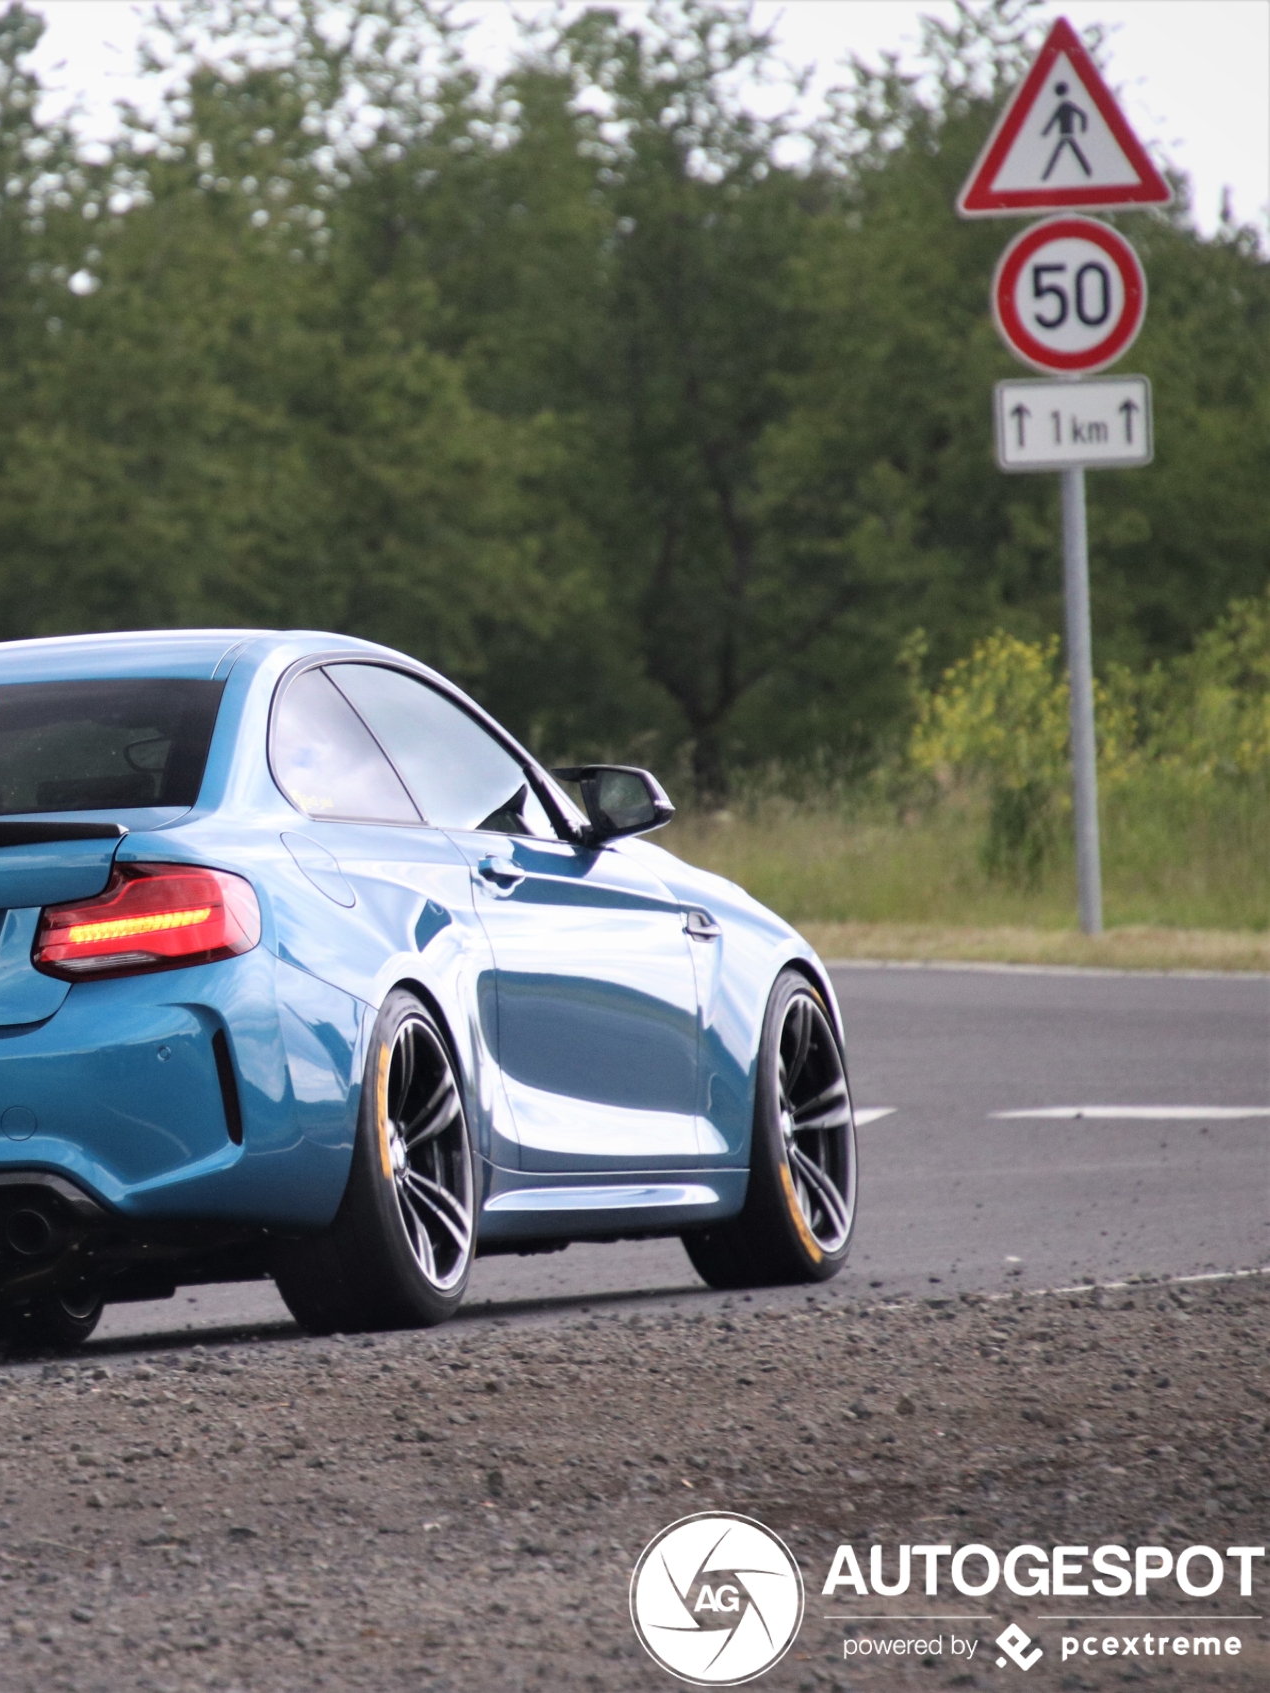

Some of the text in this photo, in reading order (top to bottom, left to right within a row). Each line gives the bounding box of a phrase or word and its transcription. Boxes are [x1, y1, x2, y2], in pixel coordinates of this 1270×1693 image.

[1032, 261, 1111, 329] 50
[1051, 410, 1108, 444] 1 km
